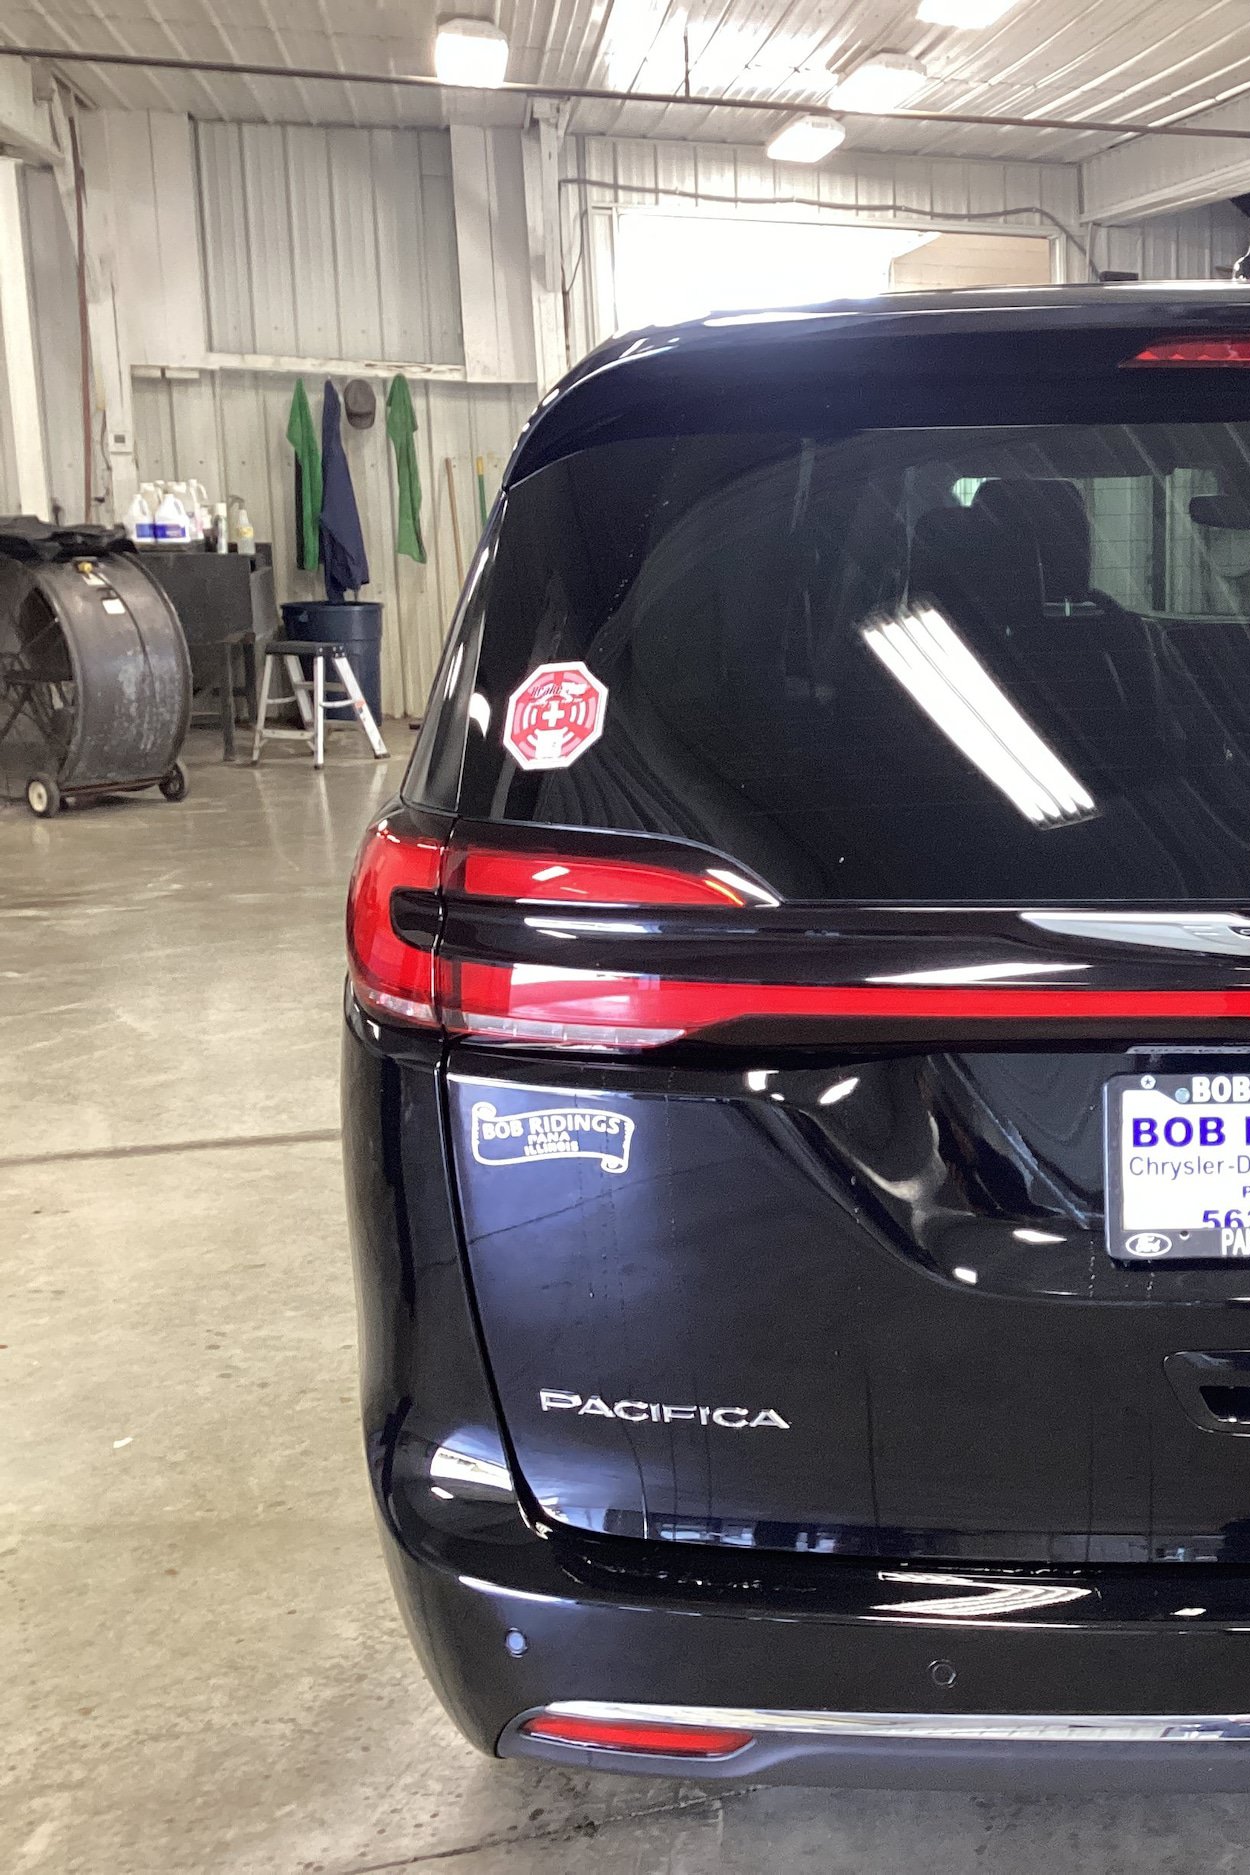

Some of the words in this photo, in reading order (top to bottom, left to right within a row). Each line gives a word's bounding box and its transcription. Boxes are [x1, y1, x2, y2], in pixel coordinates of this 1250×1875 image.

[481, 1119, 524, 1140] BOB
[528, 1113, 621, 1134] RIDINGS
[1132, 1117, 1226, 1148] BOB
[539, 1387, 791, 1430] PACIFICA
